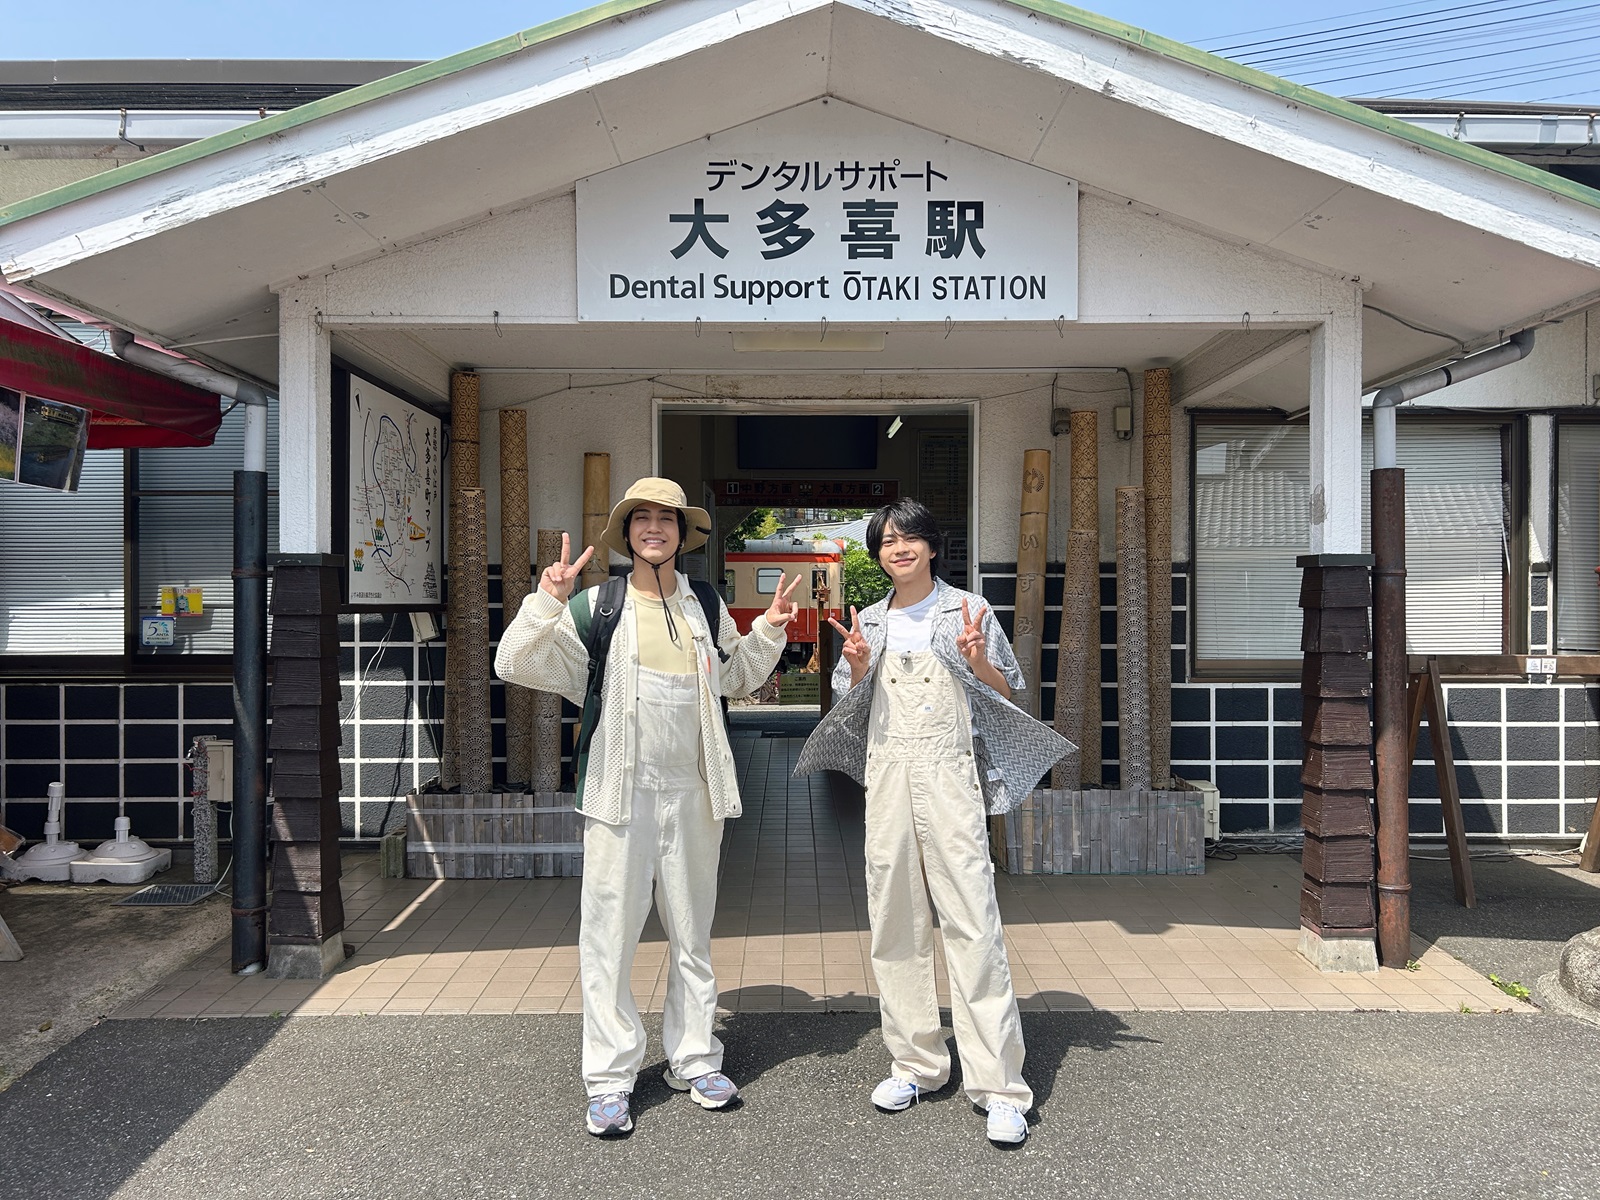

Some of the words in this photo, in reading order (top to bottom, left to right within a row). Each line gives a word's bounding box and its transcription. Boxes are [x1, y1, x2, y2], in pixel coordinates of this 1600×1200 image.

[706, 158, 949, 193] デンタルサポート
[669, 197, 987, 261] 大多喜駅
[609, 272, 705, 299] Dental
[713, 273, 830, 306] Support
[932, 275, 1046, 301] STATION
